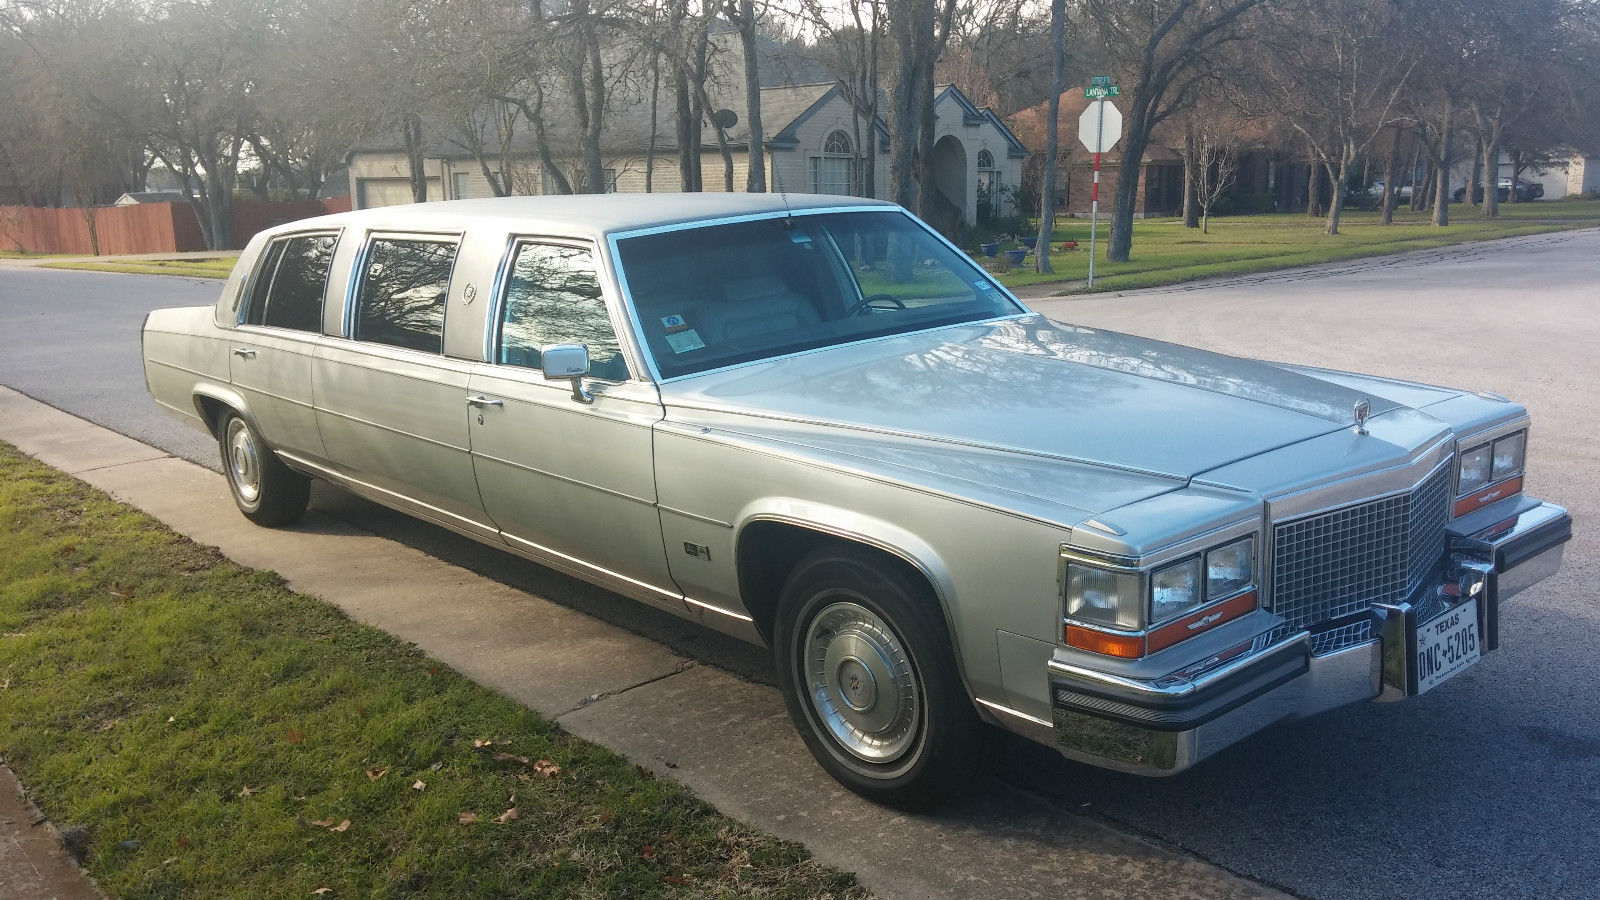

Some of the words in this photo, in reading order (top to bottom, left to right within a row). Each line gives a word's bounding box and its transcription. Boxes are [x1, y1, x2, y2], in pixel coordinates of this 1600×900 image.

[1086, 88, 1109, 97] LANTANA
[1110, 86, 1120, 95] TRL
[1434, 613, 1460, 635] TEXAS
